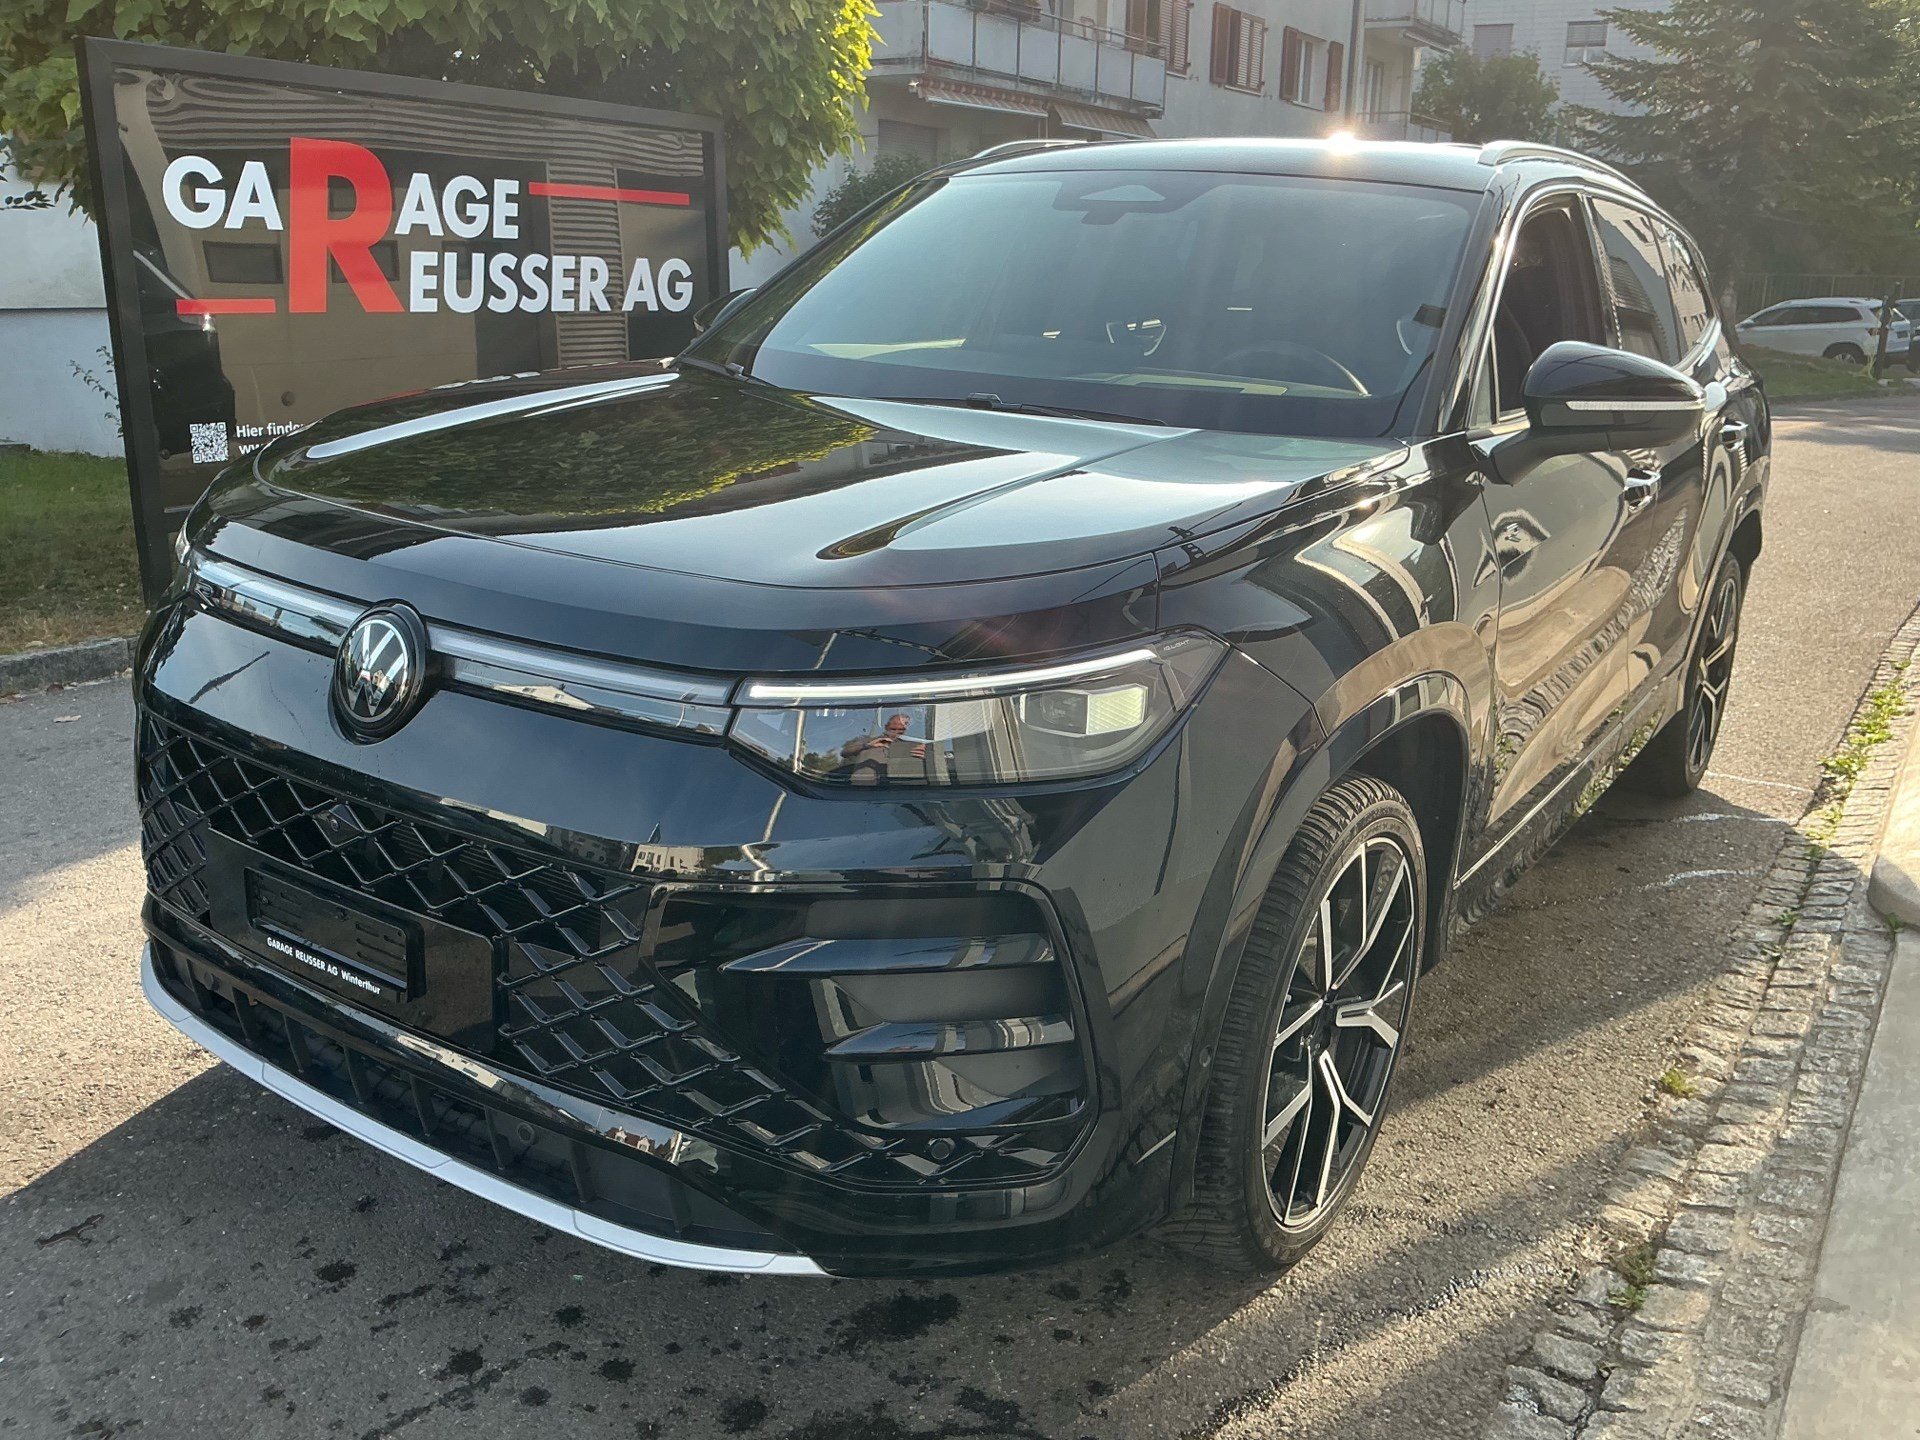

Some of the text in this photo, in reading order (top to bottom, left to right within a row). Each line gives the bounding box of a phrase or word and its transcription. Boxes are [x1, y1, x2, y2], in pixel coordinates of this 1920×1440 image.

[162, 136, 520, 313] GARAGE
[621, 257, 694, 312] AG
[236, 424, 264, 438] Hier
[267, 936, 381, 995] GARAGE REUSSER AG Winterthur
